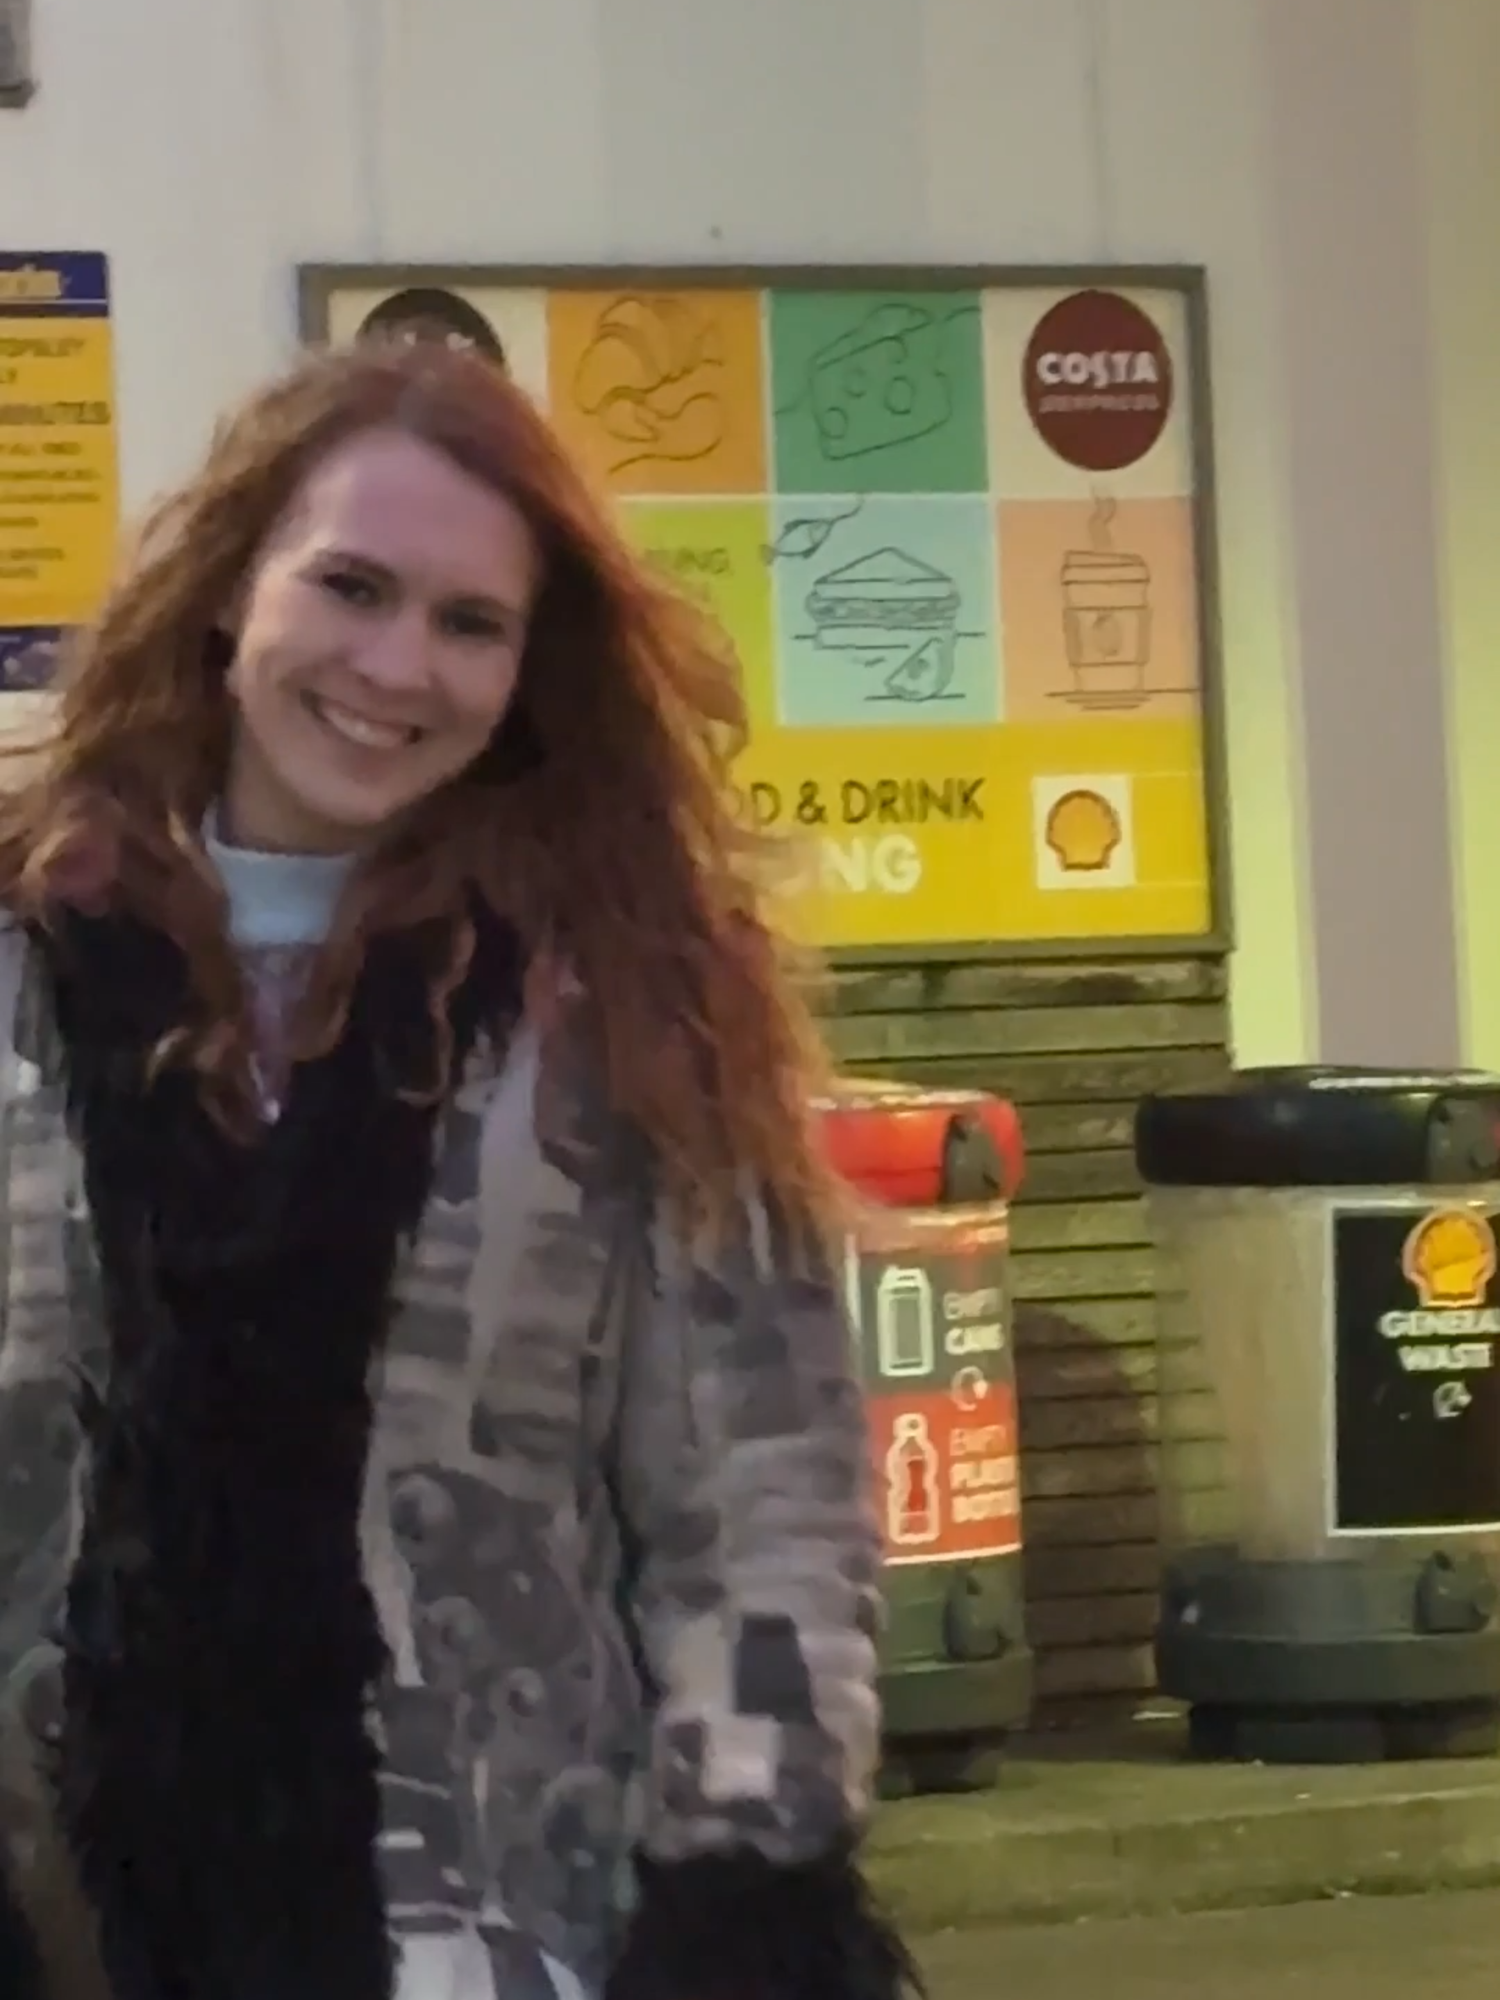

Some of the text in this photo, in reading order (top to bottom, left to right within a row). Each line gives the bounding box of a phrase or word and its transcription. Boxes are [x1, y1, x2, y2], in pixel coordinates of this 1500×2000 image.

[1037, 351, 1158, 389] COSTA
[796, 780, 827, 825] &
[840, 777, 985, 824] DRINK
[819, 834, 922, 894] NG
[1378, 1308, 1500, 1339] GENERA
